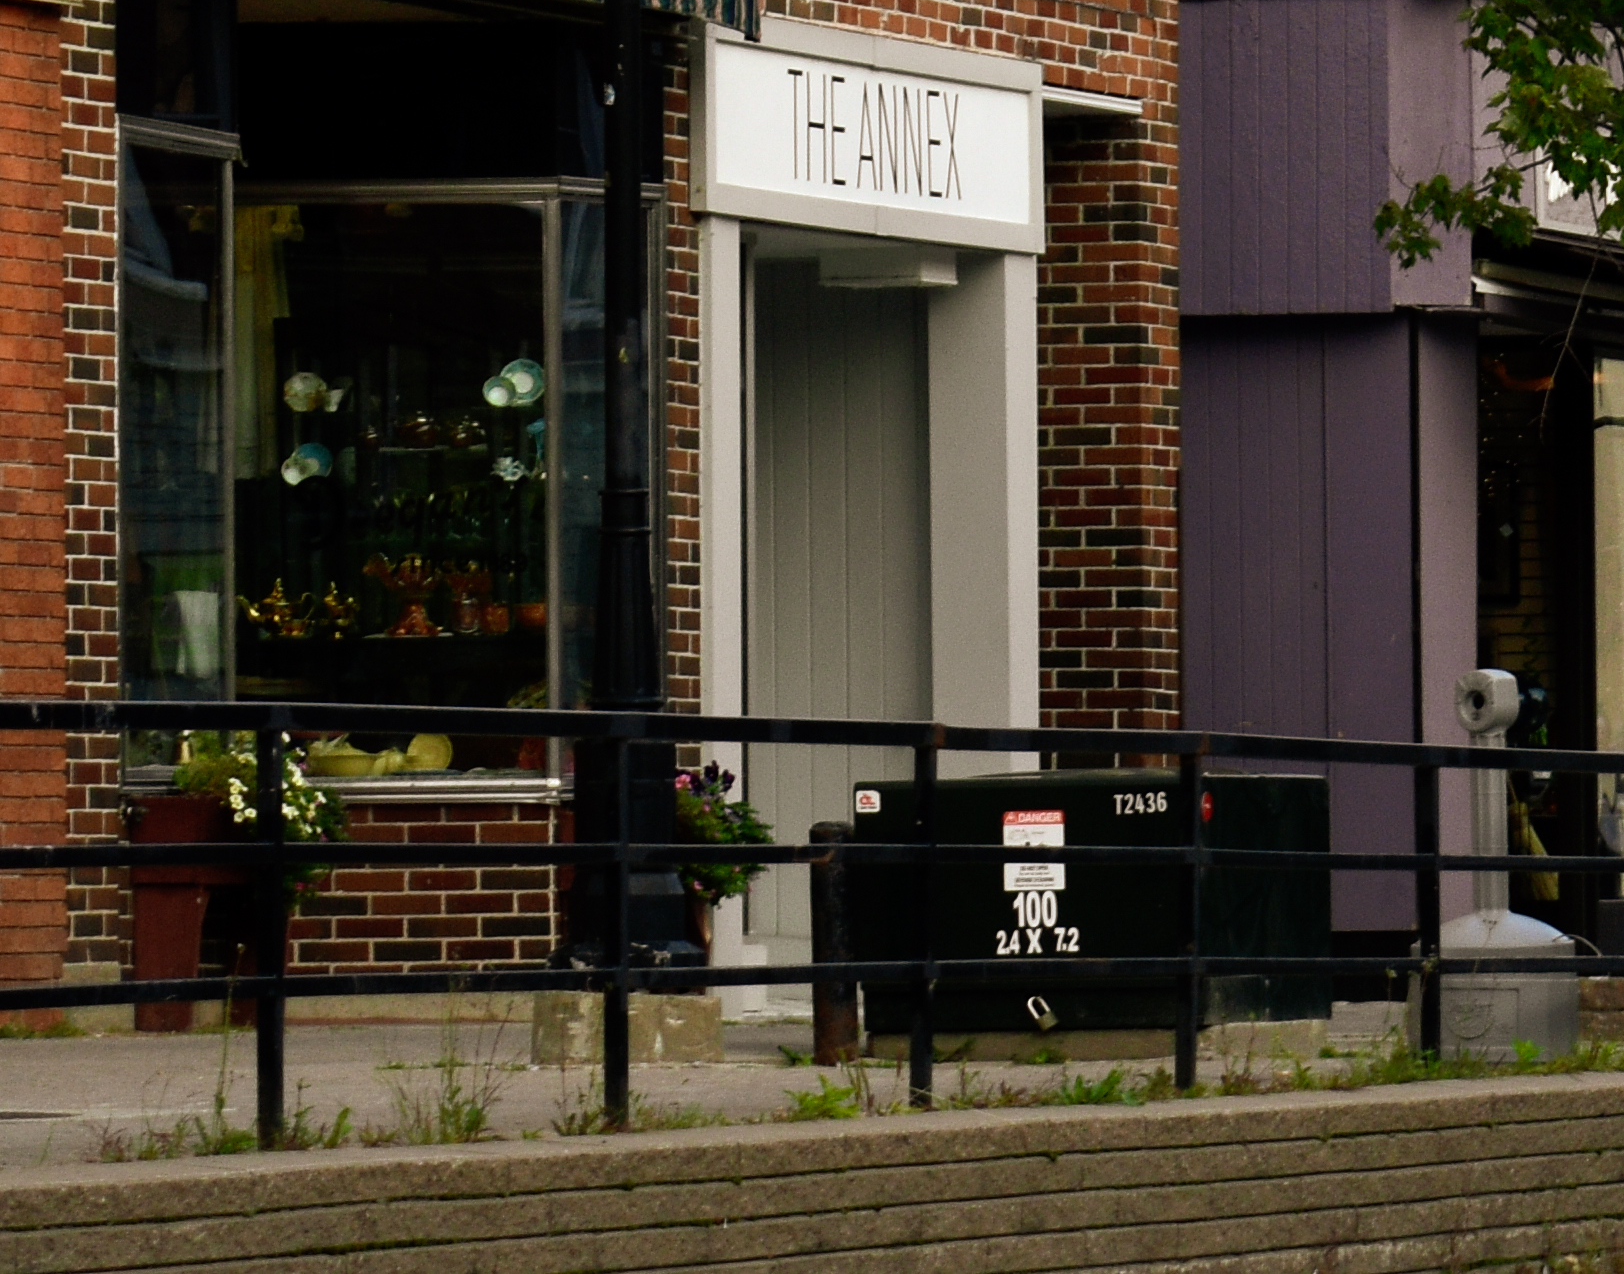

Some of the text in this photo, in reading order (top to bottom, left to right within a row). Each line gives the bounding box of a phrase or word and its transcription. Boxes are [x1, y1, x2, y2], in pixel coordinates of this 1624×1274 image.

[787, 68, 961, 199] THE ANNEX
[1114, 792, 1167, 815] T2436
[1018, 812, 1061, 823] DANGER
[1013, 891, 1057, 928] 100
[1054, 927, 1080, 952] 7.2
